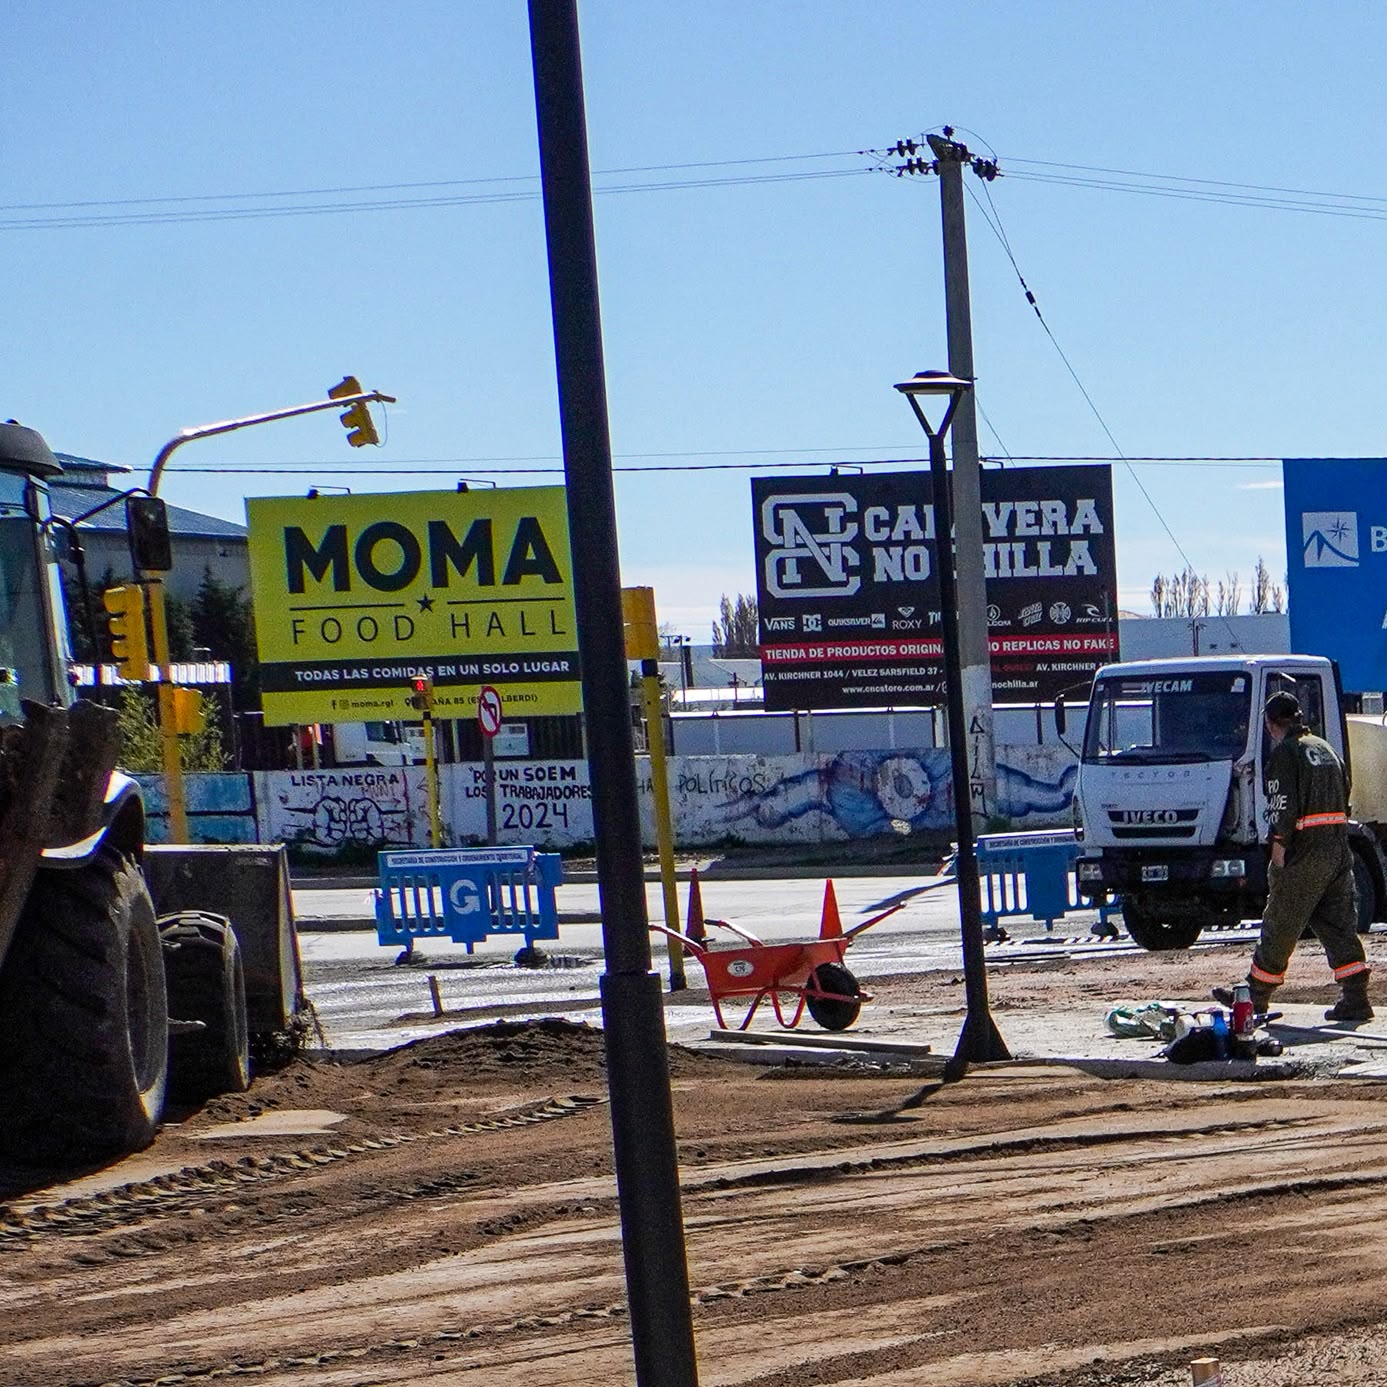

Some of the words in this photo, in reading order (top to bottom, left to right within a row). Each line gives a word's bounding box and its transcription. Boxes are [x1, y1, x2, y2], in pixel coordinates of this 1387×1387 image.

[283, 517, 563, 594] MOMA
[872, 545, 931, 582] NO
[292, 616, 415, 645] FOOD
[451, 609, 566, 639] HALL
[764, 617, 795, 631] VANS
[892, 619, 922, 630] ROXY
[1003, 640, 1060, 651] REPLICAS
[1063, 639, 1081, 649] NO
[1084, 638, 1114, 649] FAKE
[765, 648, 806, 660] TIENDA
[809, 647, 824, 658] DE
[827, 645, 897, 657] PRODUCTOS
[294, 669, 339, 681] TODAS
[343, 668, 369, 679] LAS
[372, 666, 434, 679] COMIDAS
[438, 666, 457, 676] EN
[460, 664, 479, 675] UN
[482, 663, 519, 674] SOLO
[523, 661, 570, 673] LUGAR
[764, 672, 777, 681] AV.
[779, 671, 822, 681] KIRCHNER
[852, 669, 878, 677] VELEZ
[879, 667, 925, 676] SARSFIELD
[927, 667, 938, 675] 37
[1036, 663, 1050, 672] AV.
[1052, 663, 1096, 671] KIRCHNER
[291, 774, 338, 787] LISTA
[342, 773, 399, 786] NEGRA
[499, 768, 519, 781] UN
[523, 766, 576, 781] SOEM
[502, 802, 569, 829] 2024
[1122, 809, 1178, 824] IVECO
[450, 879, 481, 915] G
